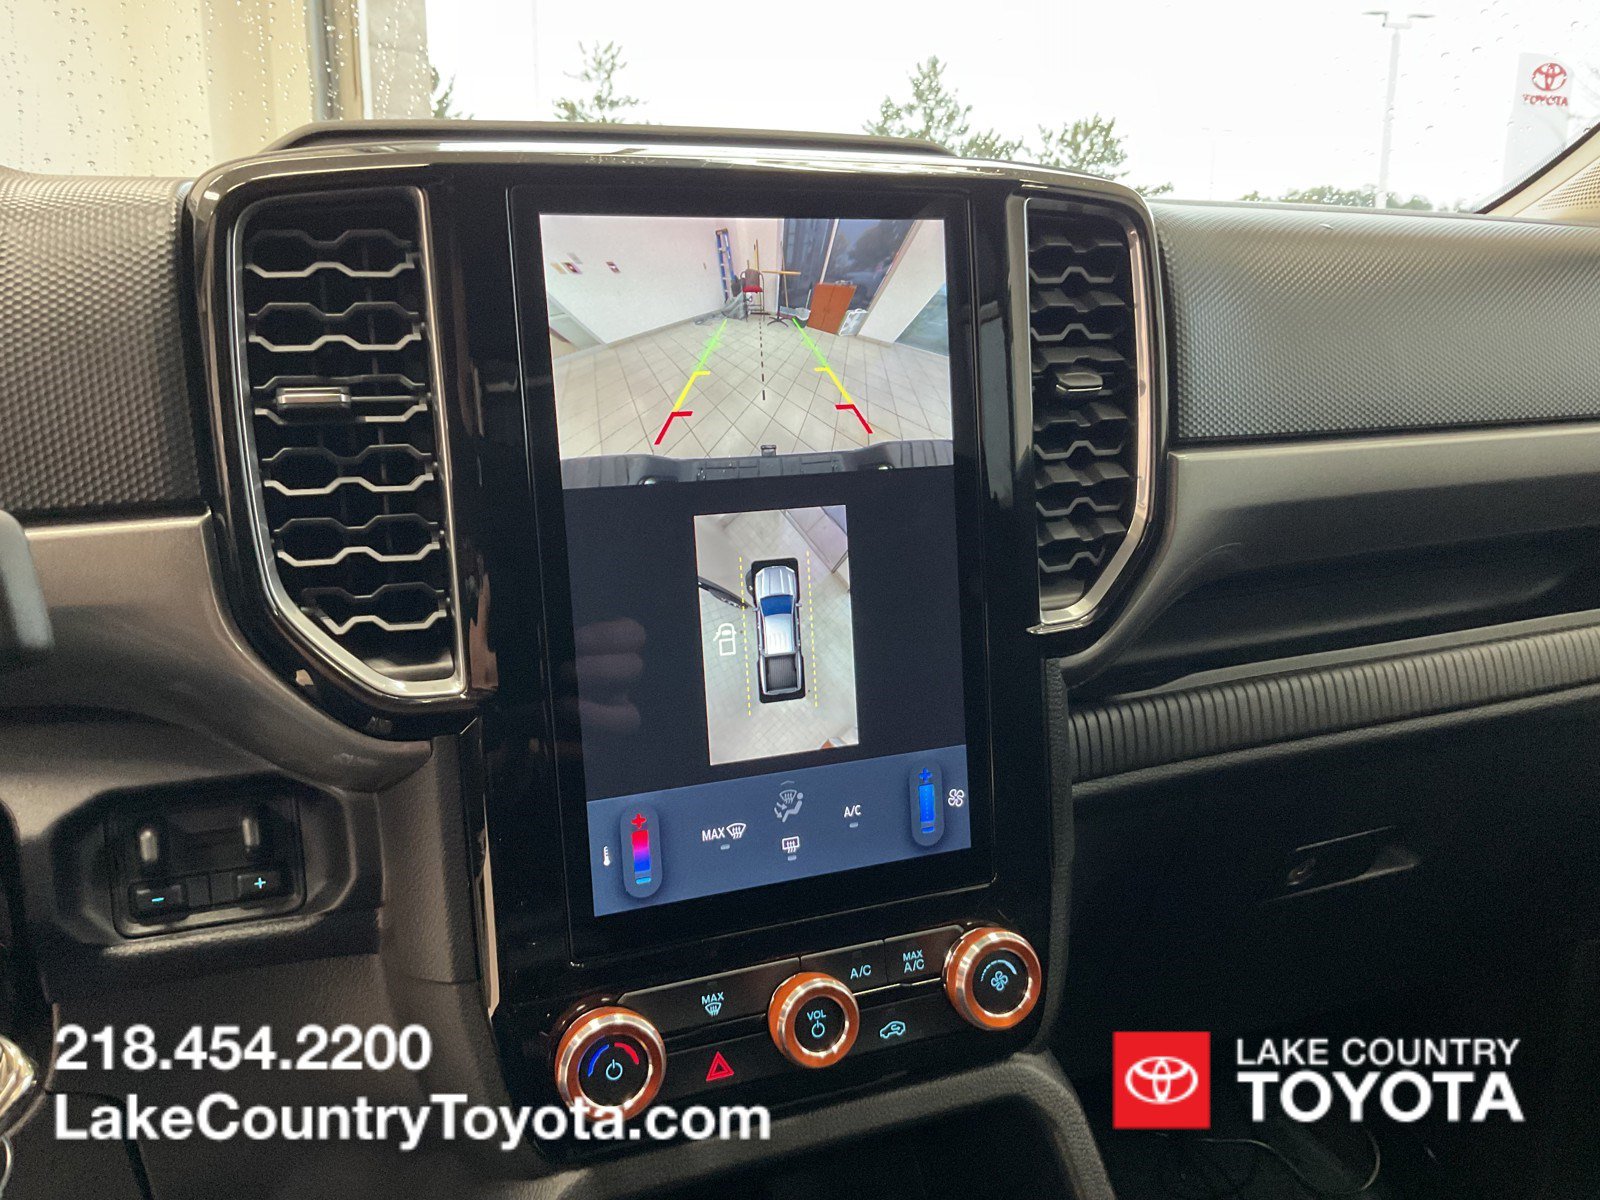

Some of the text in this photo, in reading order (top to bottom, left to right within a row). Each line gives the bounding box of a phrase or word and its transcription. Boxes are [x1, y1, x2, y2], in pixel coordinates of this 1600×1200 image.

[1522, 94, 1568, 106] TOYOTA
[843, 804, 862, 818] A/C
[701, 826, 726, 842] MAX
[902, 950, 923, 961] MAX
[849, 963, 872, 980] A/C
[903, 960, 925, 974] A/C
[701, 991, 725, 1005] MAX
[806, 1010, 827, 1021] VOL
